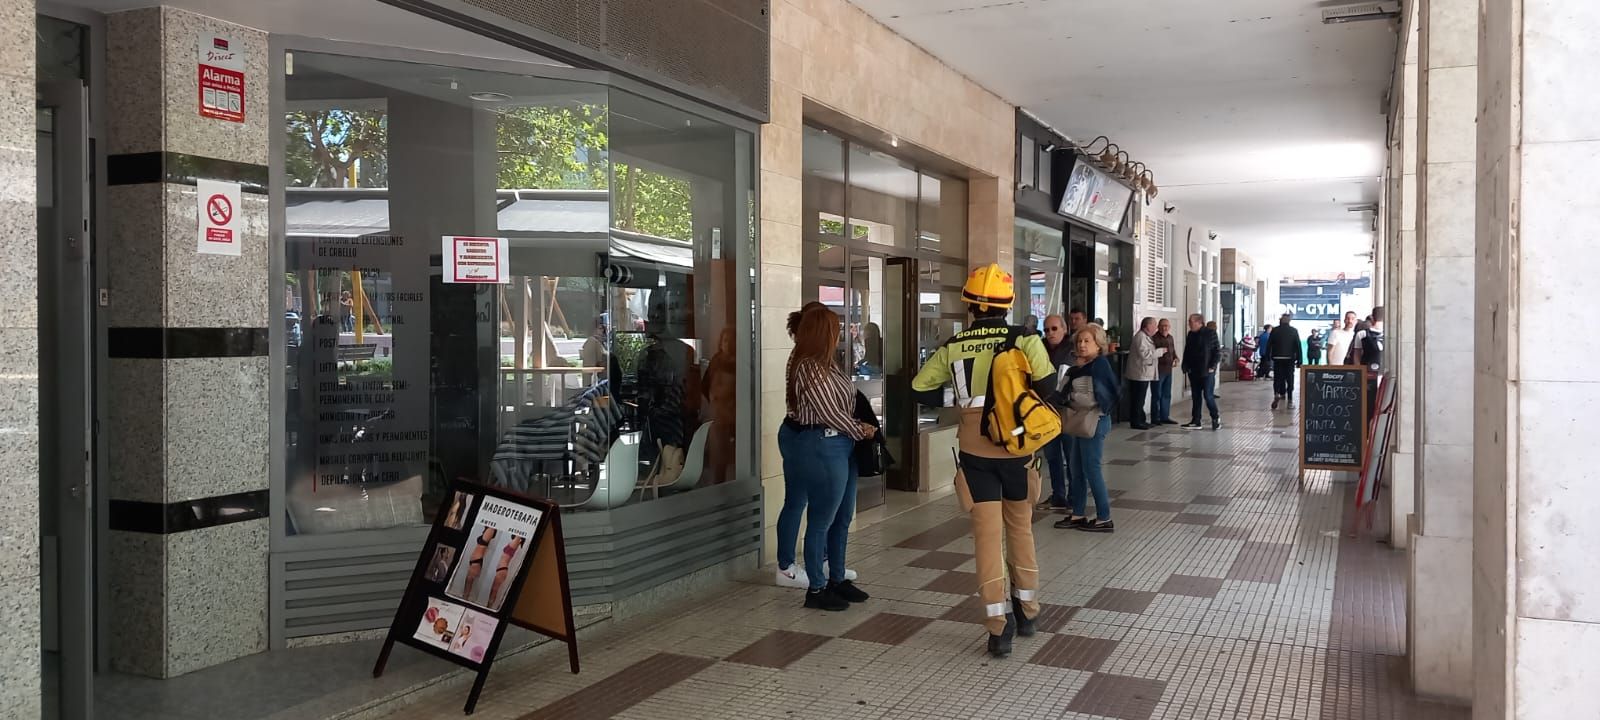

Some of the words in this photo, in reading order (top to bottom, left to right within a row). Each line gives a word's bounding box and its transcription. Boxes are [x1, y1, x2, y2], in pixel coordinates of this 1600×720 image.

[203, 68, 240, 86] Alarma
[319, 247, 327, 257] DE
[329, 247, 357, 258] CABELLO
[482, 502, 538, 526] MADEROTERAPIA
